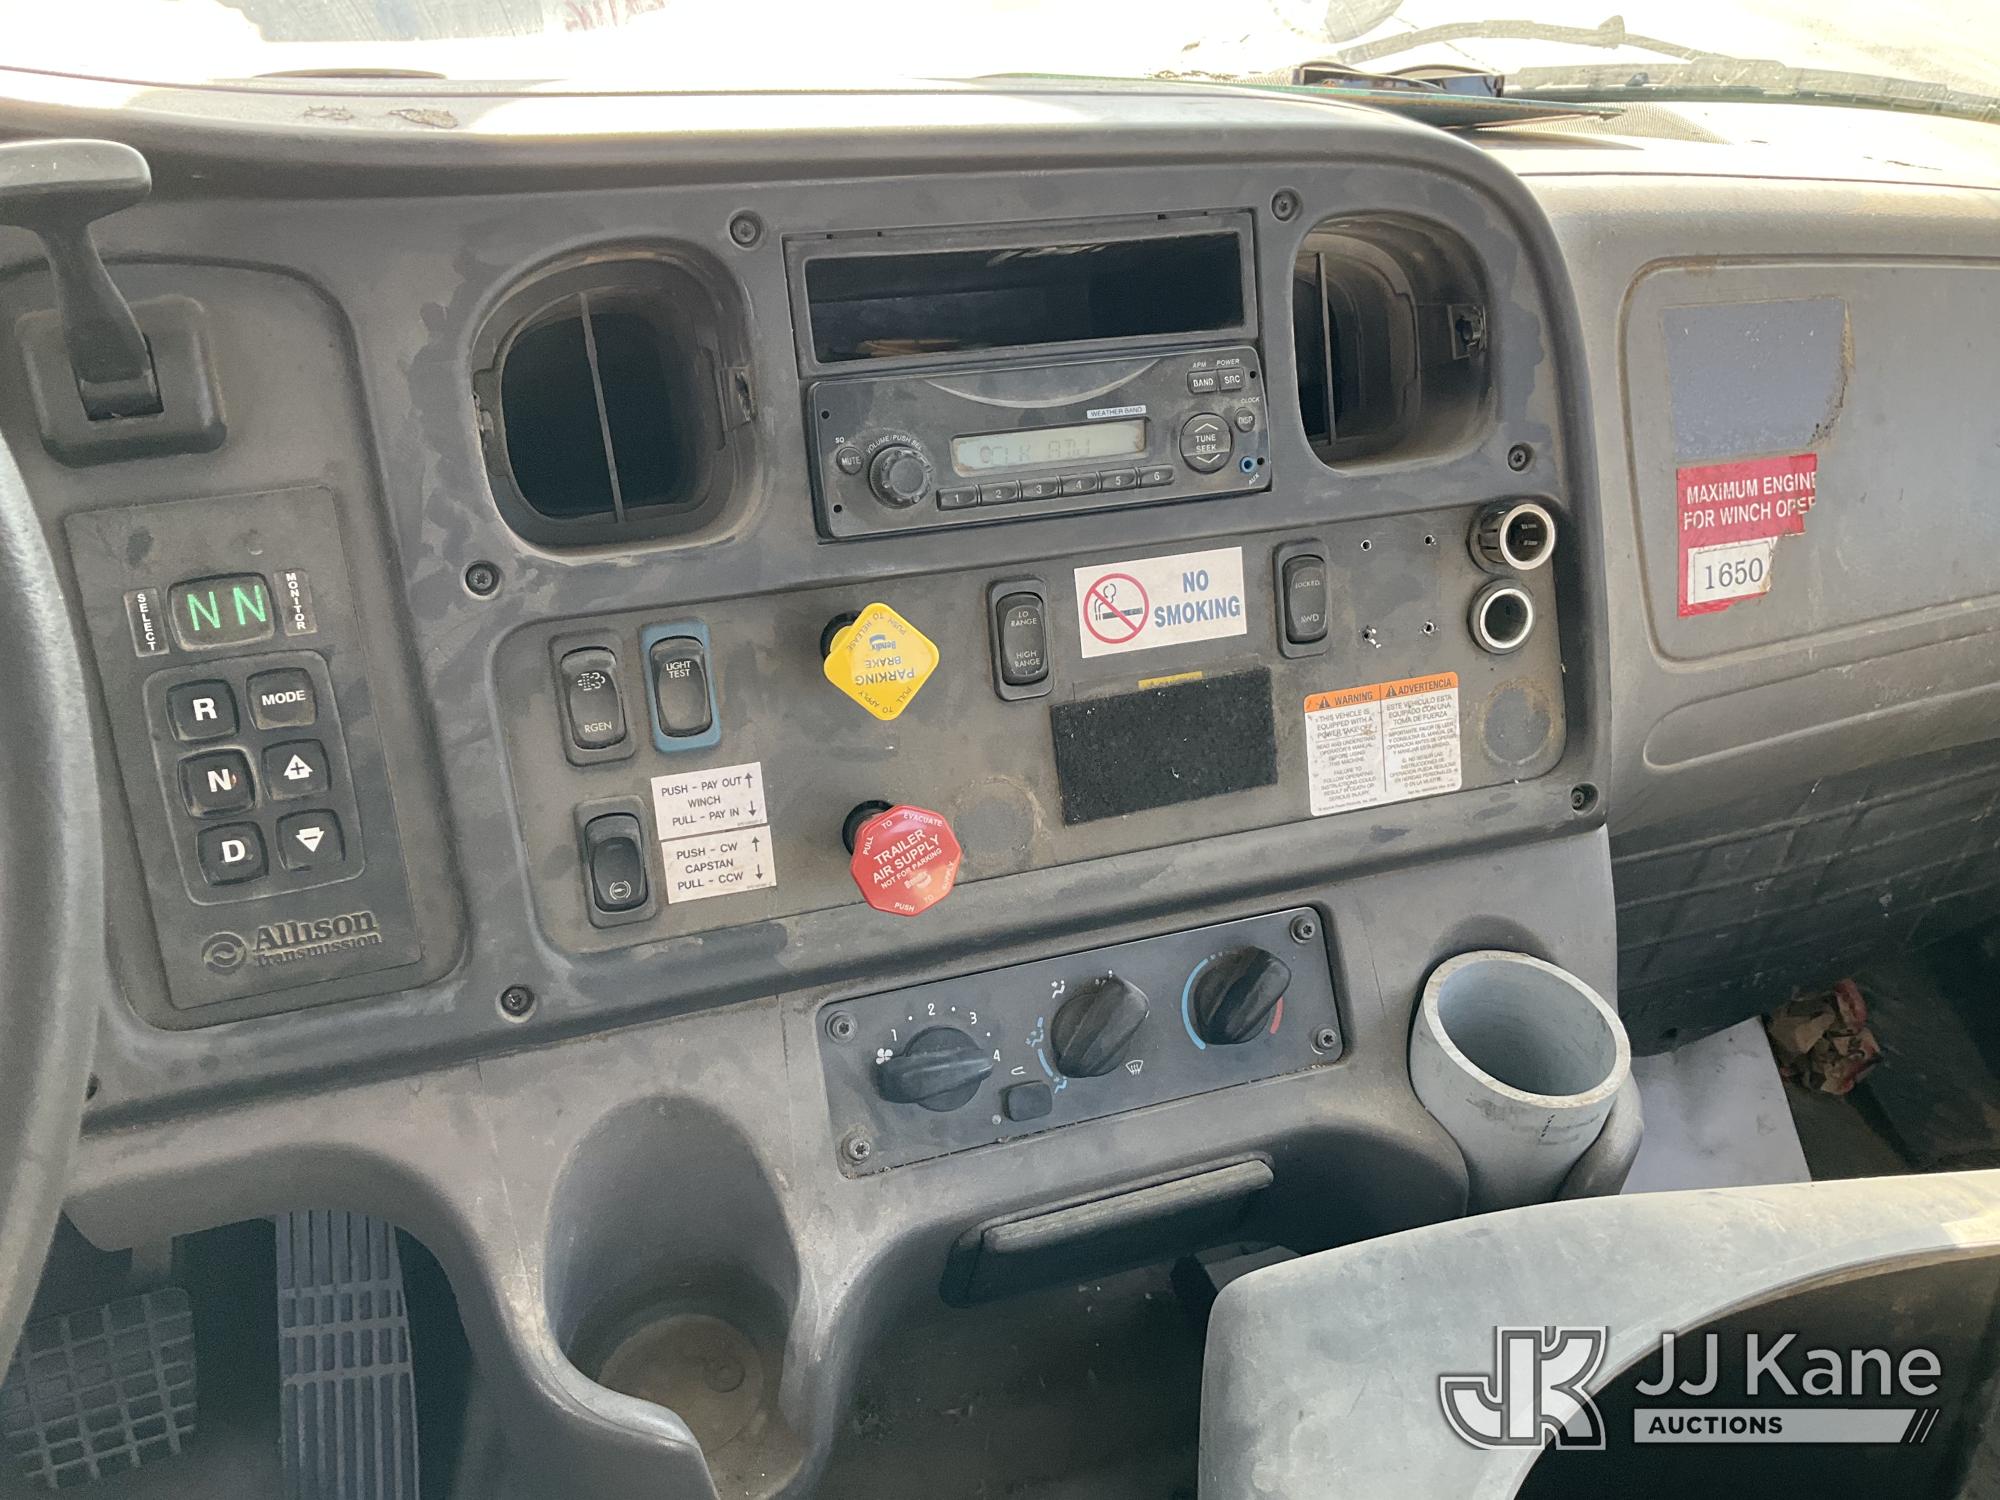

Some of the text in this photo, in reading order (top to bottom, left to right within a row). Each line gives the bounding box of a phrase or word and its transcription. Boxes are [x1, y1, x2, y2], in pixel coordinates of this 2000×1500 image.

[1216, 358, 1240, 366] POWER
[1193, 378, 1214, 388] BAND
[1224, 374, 1240, 384] SRC
[1240, 396, 1260, 404] CLOCK
[1091, 406, 1142, 418] WEATHER BAND
[1238, 415, 1253, 424] DISP
[1196, 434, 1216, 443] TUNE
[1196, 444, 1216, 453] SEEK
[842, 457, 861, 465] MUTE
[1115, 476, 1121, 485] 5
[1154, 471, 1160, 480] 6
[1248, 473, 1260, 485] AUX
[1036, 484, 1042, 494] 3
[1076, 480, 1082, 489] 4
[955, 494, 959, 502] 1
[996, 490, 1002, 498] 2
[1687, 479, 1758, 504] MAXIMUM
[1684, 510, 1715, 530] FOR
[1720, 502, 1771, 526] WINCH
[1705, 557, 1763, 590] 1650
[1182, 570, 1209, 593] NO
[1296, 580, 1320, 589] LOCKED
[286, 572, 306, 630] MONITOR
[1154, 596, 1241, 628] SMOKING
[136, 593, 157, 650] SELECT
[888, 618, 907, 635] PUSH
[1011, 618, 1037, 627] RANGE
[847, 621, 873, 650] RELEASE
[1016, 650, 1036, 659] HIGH
[666, 660, 691, 671] LIGHT
[865, 656, 902, 669] BRAKE
[1015, 658, 1040, 667] RANGE
[669, 668, 691, 678] TEST
[856, 668, 915, 686] PARKING
[1398, 679, 1452, 695] ADVERTENCIA
[261, 690, 306, 706] MODE
[857, 687, 912, 714] PULL TO APPLY
[1335, 691, 1372, 705] WARNING
[193, 697, 218, 721] R
[1335, 710, 1362, 720] VEHICLE
[1389, 708, 1420, 718] EQUIPADO
[1423, 712, 1448, 720] FUERZA
[584, 721, 612, 734] RGEN
[1317, 720, 1349, 730] EQUIPPED
[1350, 716, 1367, 725] WITH
[1317, 731, 1342, 739] POWER
[208, 768, 233, 792] N
[661, 785, 688, 797] PUSH
[701, 780, 718, 791] PAY
[722, 776, 742, 787] OUT
[688, 796, 720, 808] WINCH
[672, 815, 697, 826] PULL
[709, 810, 726, 821] PAY
[730, 808, 740, 817] IN
[863, 812, 943, 855] PULL TO EVACUATE
[221, 840, 246, 862] D
[676, 847, 706, 860] PUSH
[720, 842, 738, 853] CW
[874, 828, 926, 865] TRAILER
[873, 834, 940, 884] AIR SUPPLY
[685, 858, 734, 874] CAPSTAN
[881, 847, 942, 889] NOT FOR PARKING
[677, 879, 704, 890] PULL
[718, 872, 744, 884] CCW
[894, 902, 915, 912] PUSH
[253, 910, 379, 952] Allison
[927, 1003, 936, 1016] 2
[969, 1012, 977, 1024] 3
[891, 1029, 897, 1042] 1
[993, 1049, 1000, 1061] 4
